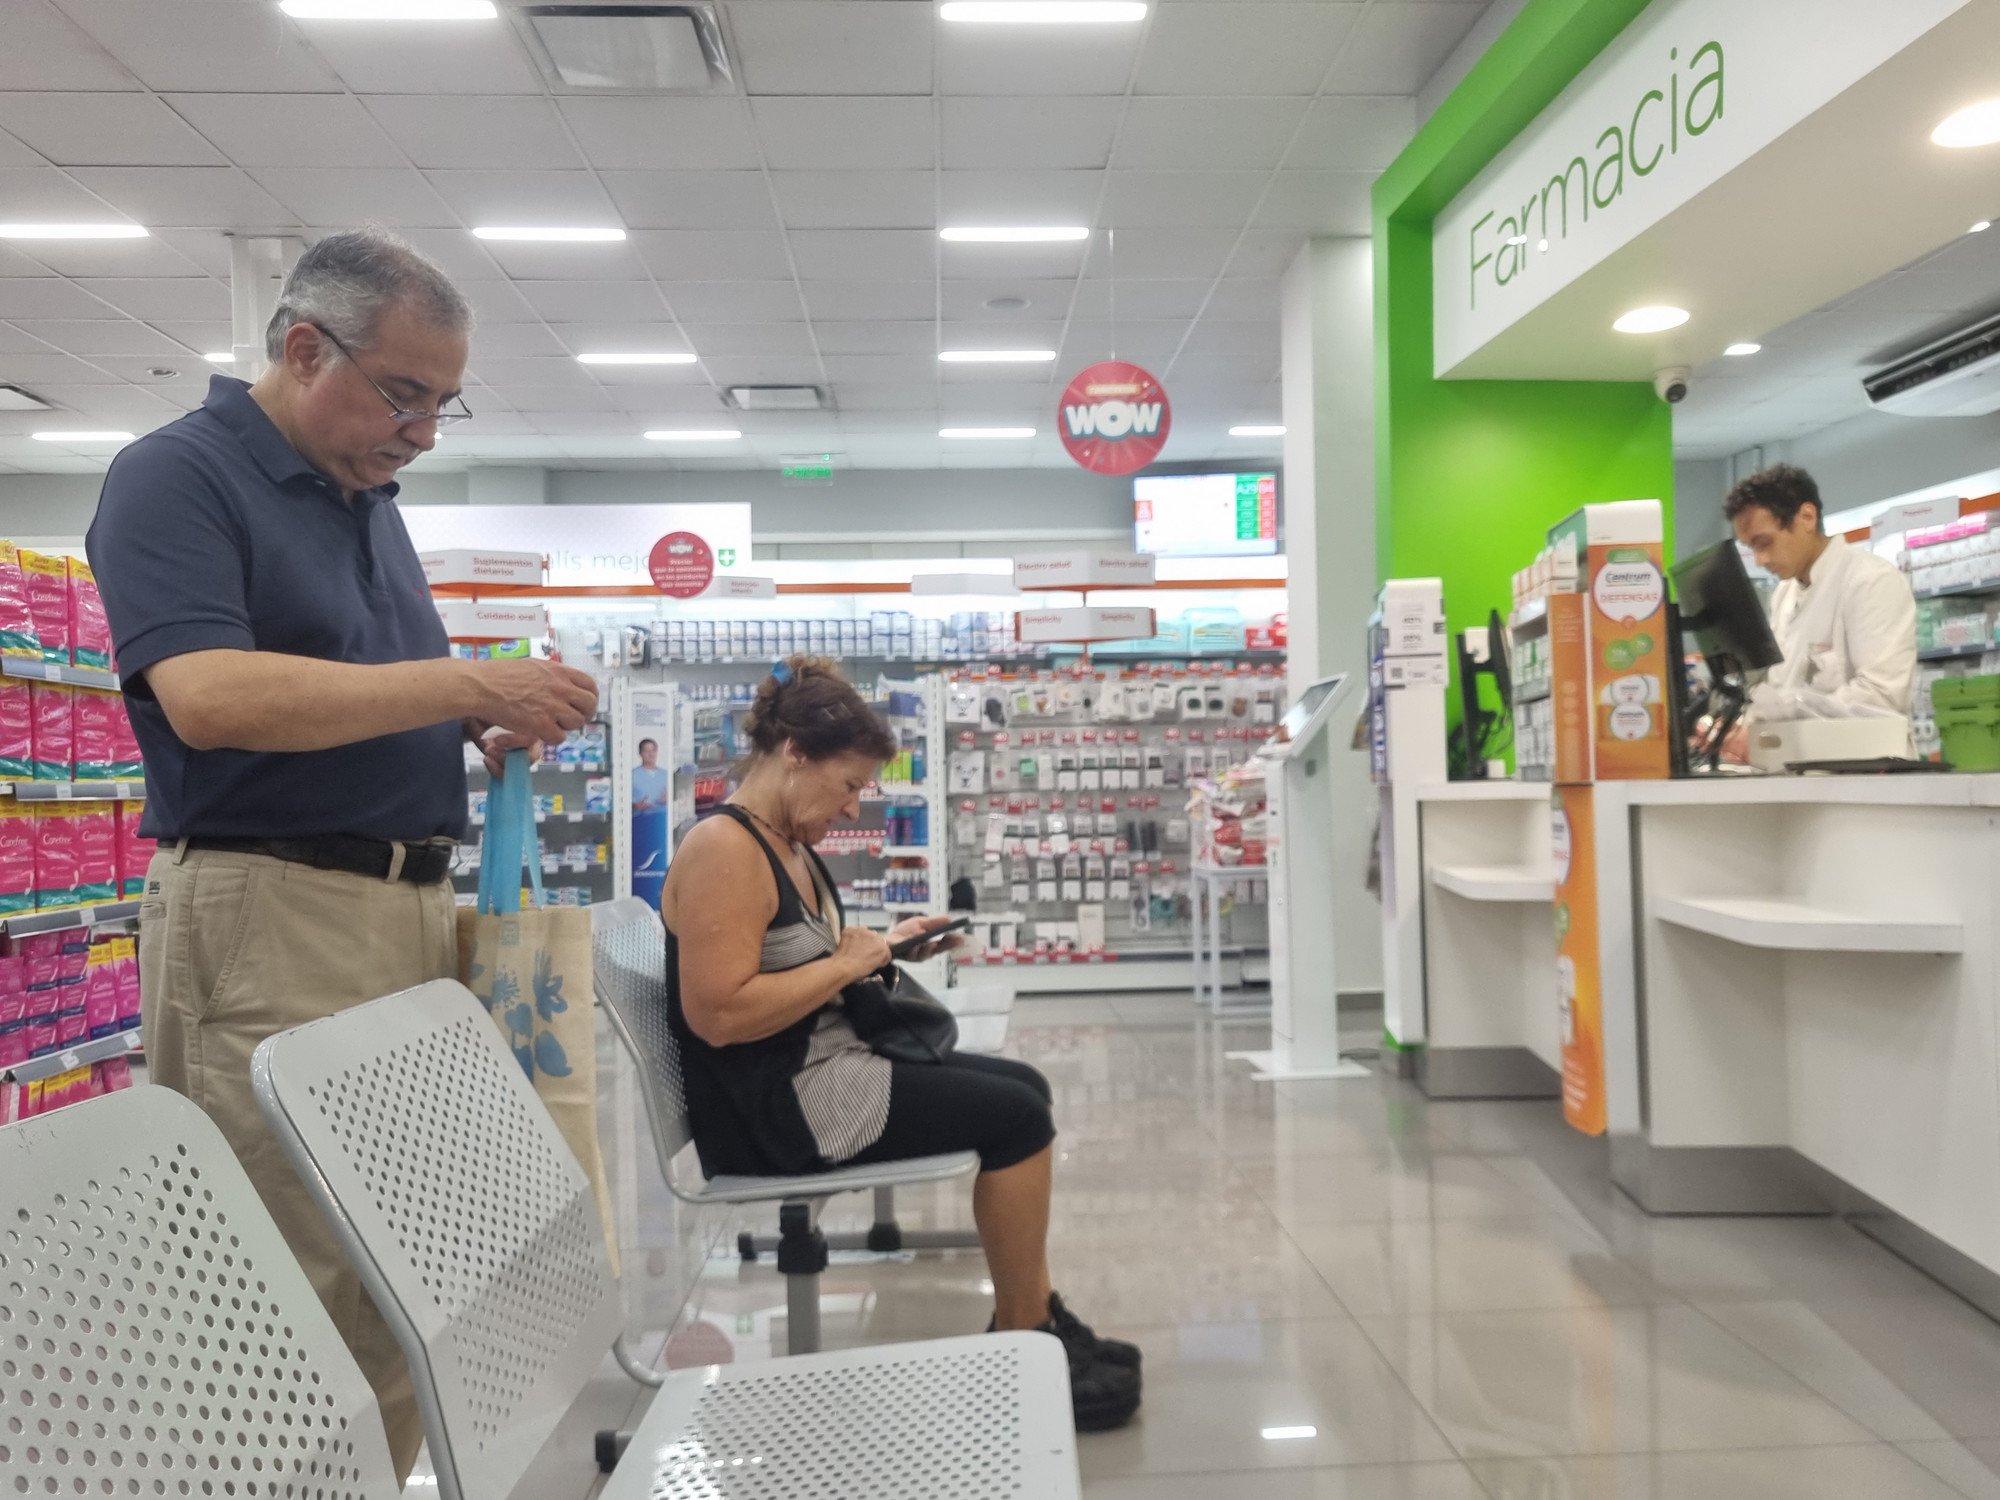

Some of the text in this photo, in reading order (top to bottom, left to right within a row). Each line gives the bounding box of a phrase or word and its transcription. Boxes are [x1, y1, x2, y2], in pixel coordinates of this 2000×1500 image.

[1470, 41, 1724, 310] Farmacia
[1065, 400, 1162, 440] WOW
[1605, 571, 1652, 583] Centrum
[477, 611, 516, 621] Cuidado
